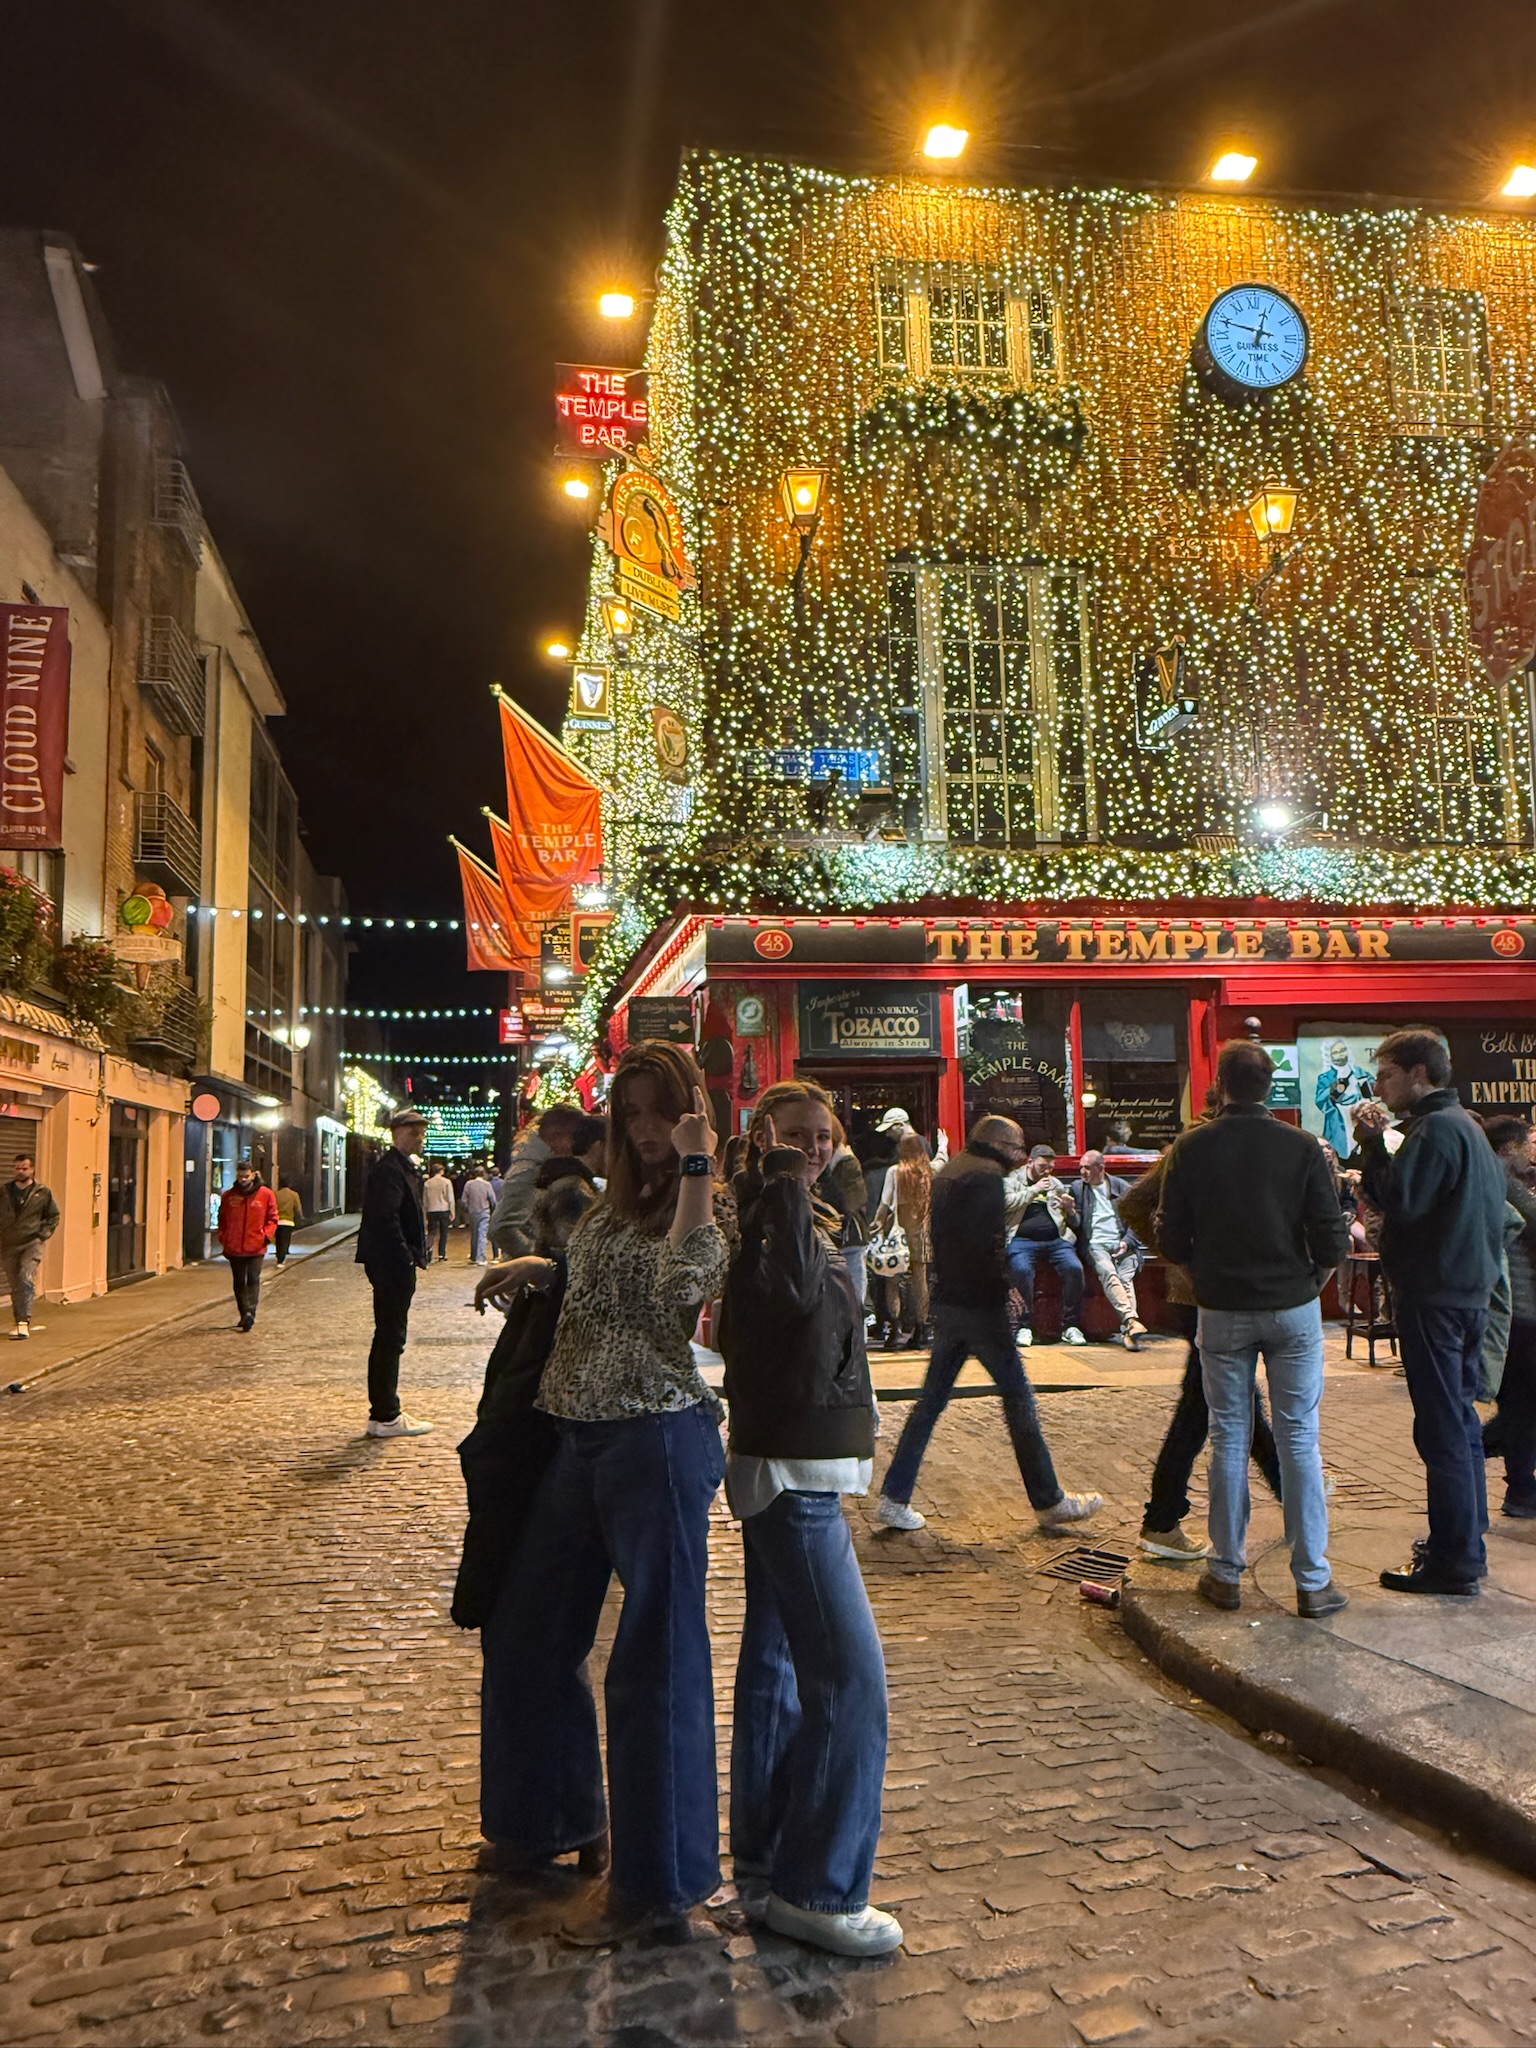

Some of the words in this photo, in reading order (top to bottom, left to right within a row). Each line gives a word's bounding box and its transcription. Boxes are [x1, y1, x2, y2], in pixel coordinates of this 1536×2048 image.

[1247, 353, 1269, 363] TIME
[578, 372, 627, 396] THE
[556, 394, 648, 421] TEMPLE
[581, 424, 628, 447] BAR
[1472, 496, 1536, 631] STO
[633, 566, 668, 592] DUBLIN
[626, 583, 645, 602] LIVE
[648, 596, 675, 616] MUSIC
[6, 613, 53, 692] NINE
[2, 704, 46, 814] CLOUD
[517, 832, 598, 848] TEMPLE
[540, 823, 573, 835] THE
[538, 849, 579, 862] BAR
[760, 934, 785, 952] 48
[926, 930, 1039, 961] THE
[1056, 929, 1266, 961] TEMPLE
[1288, 929, 1391, 960] BAR
[1495, 934, 1517, 951] 48
[854, 1006, 875, 1015] FINE
[876, 1006, 919, 1015] SMOKING
[822, 1011, 920, 1045] TOBACCO
[841, 1038, 879, 1048] Always
[883, 1038, 895, 1047] in
[897, 1038, 927, 1047] Stock
[1007, 1041, 1029, 1051] THE
[968, 1056, 1032, 1087] TEMPLE
[1036, 1061, 1067, 1089] BAR
[1512, 1058, 1536, 1080] TH
